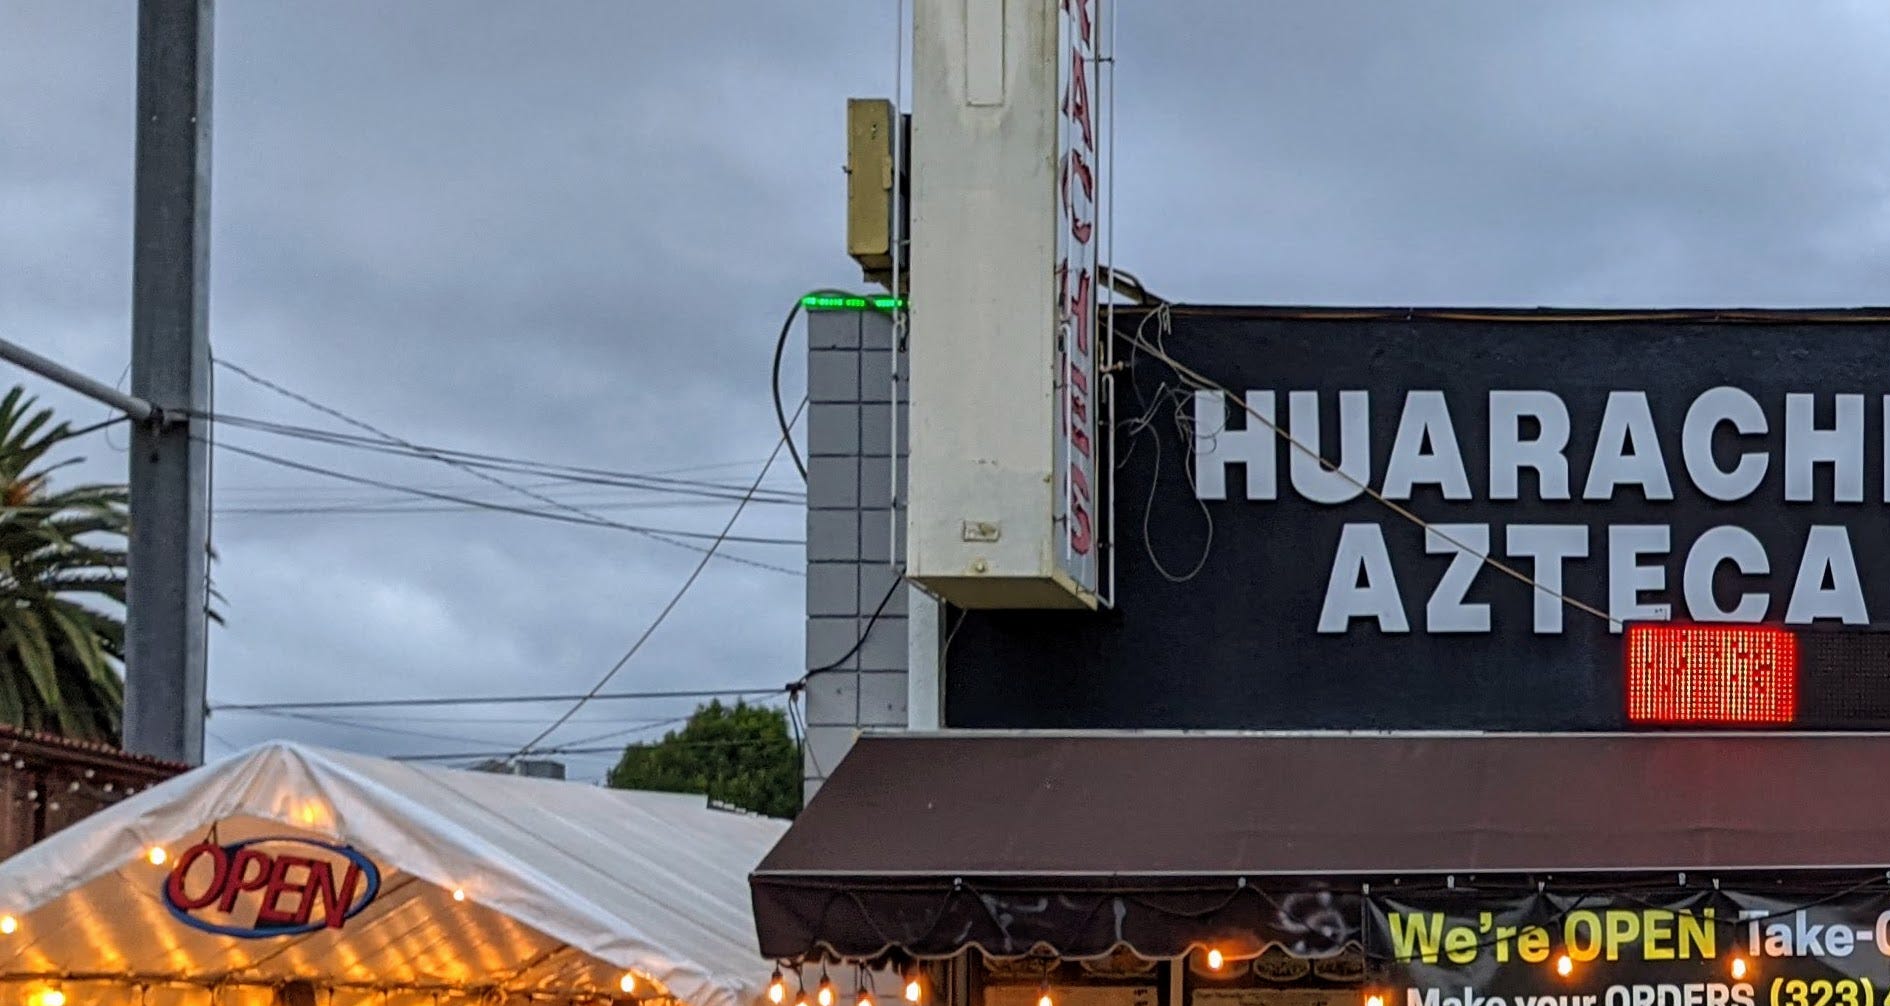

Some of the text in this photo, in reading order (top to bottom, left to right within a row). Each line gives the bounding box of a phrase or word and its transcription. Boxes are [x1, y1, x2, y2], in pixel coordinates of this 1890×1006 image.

[1317, 523, 1870, 633] AZTECA
[169, 843, 363, 929] OPEN
[1387, 911, 1549, 964] We're
[1565, 907, 1716, 962] OPEN
